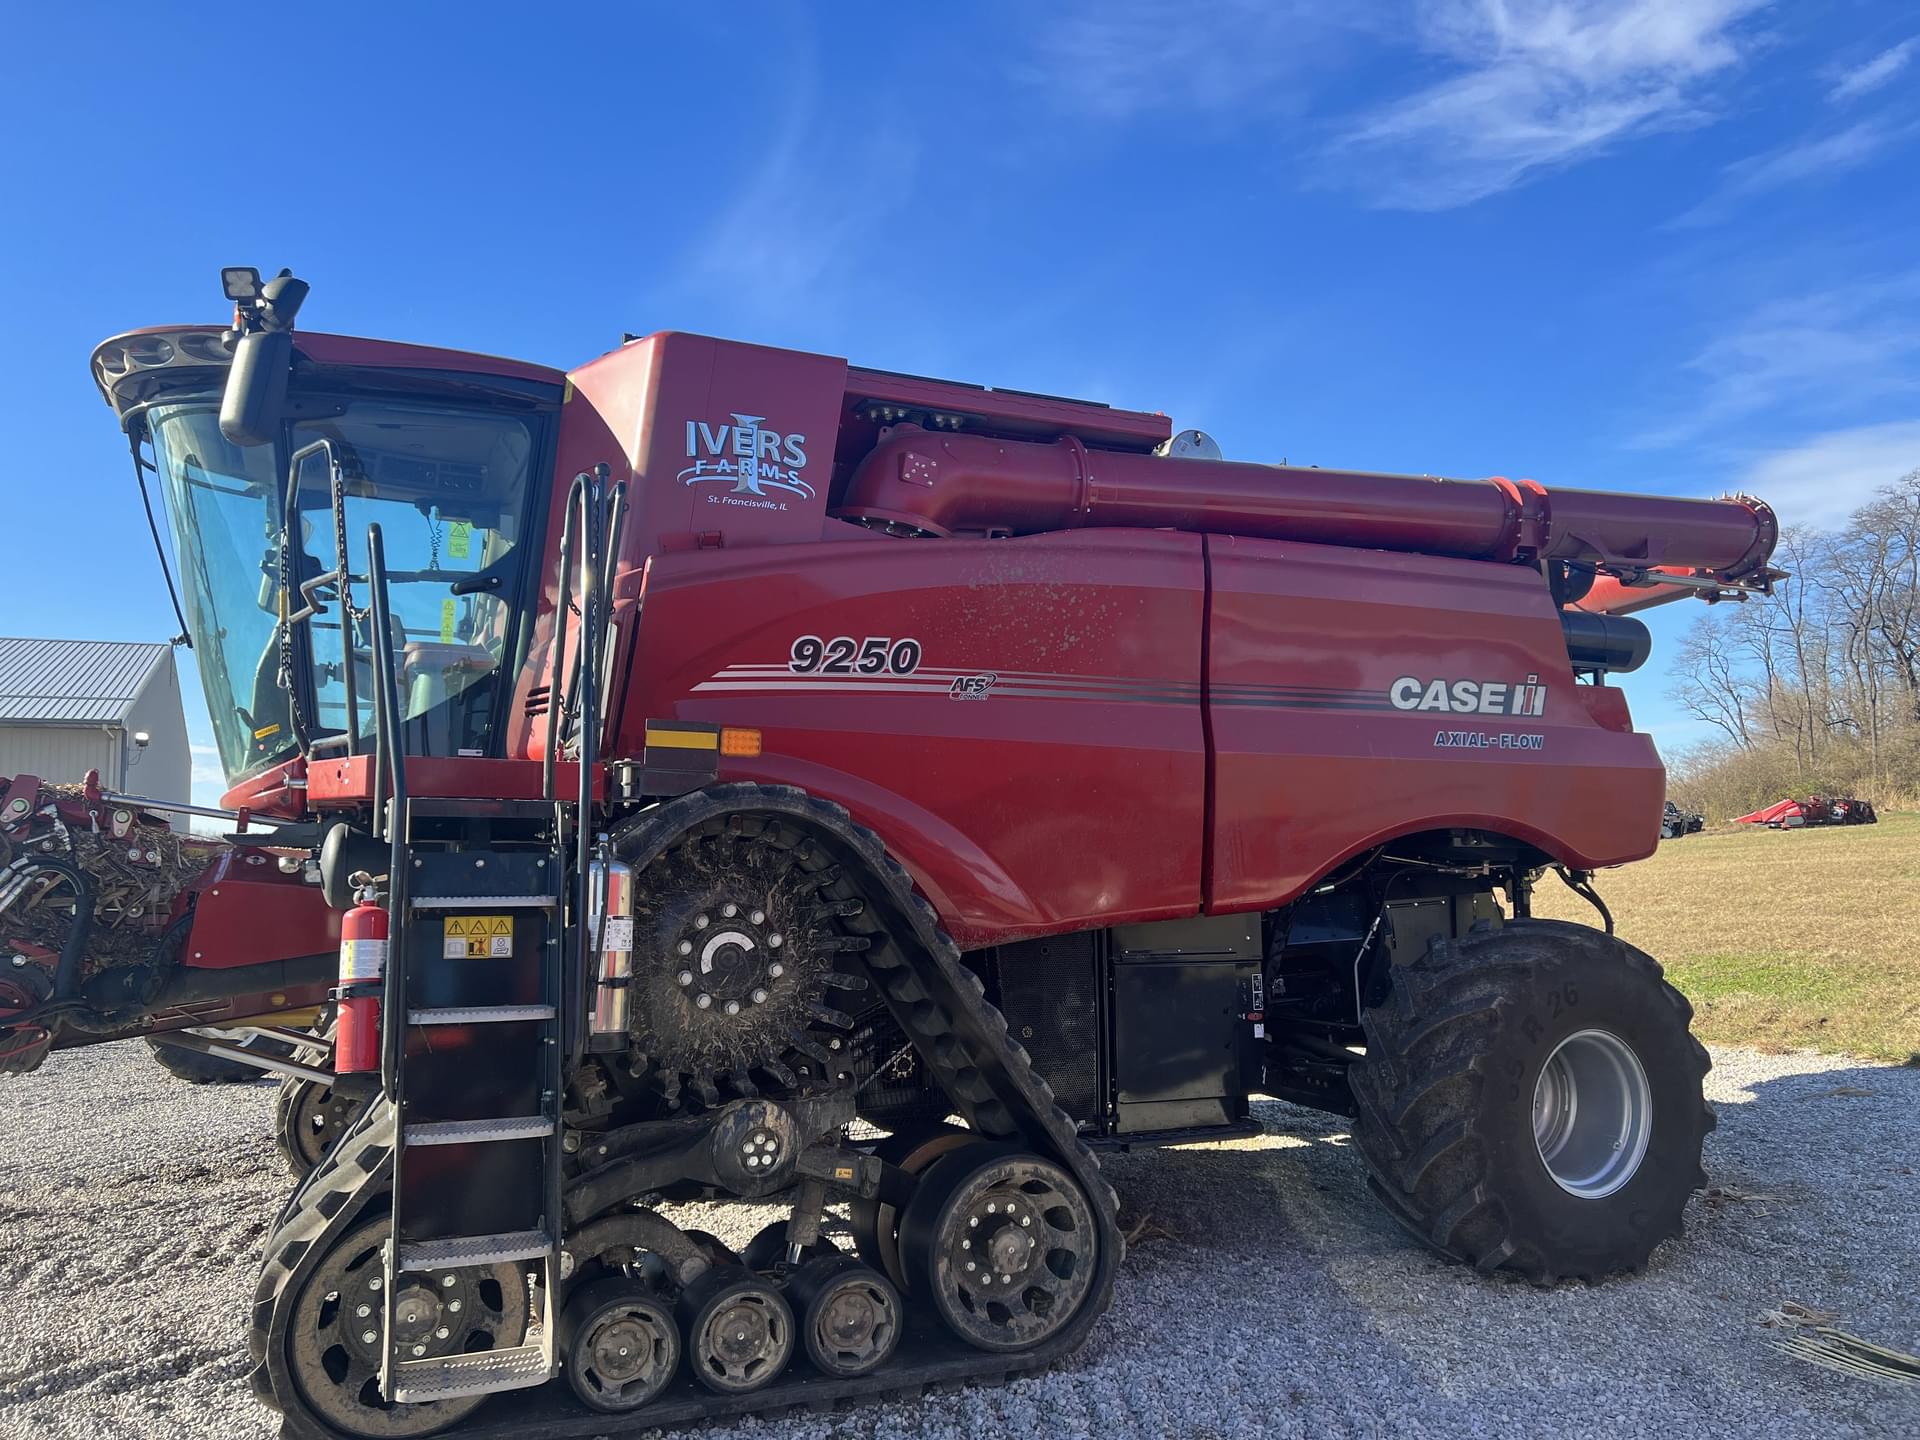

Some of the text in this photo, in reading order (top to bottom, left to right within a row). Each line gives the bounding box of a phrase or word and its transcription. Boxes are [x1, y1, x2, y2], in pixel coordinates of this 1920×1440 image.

[686, 420, 808, 469] IVERS
[695, 458, 801, 486] FARMS
[707, 495, 789, 511] St. Francisville, IL
[788, 635, 922, 677] 9250
[950, 676, 986, 693] AFS
[1390, 677, 1508, 714] CASE
[1433, 730, 1545, 751] AXIAL-FLOW
